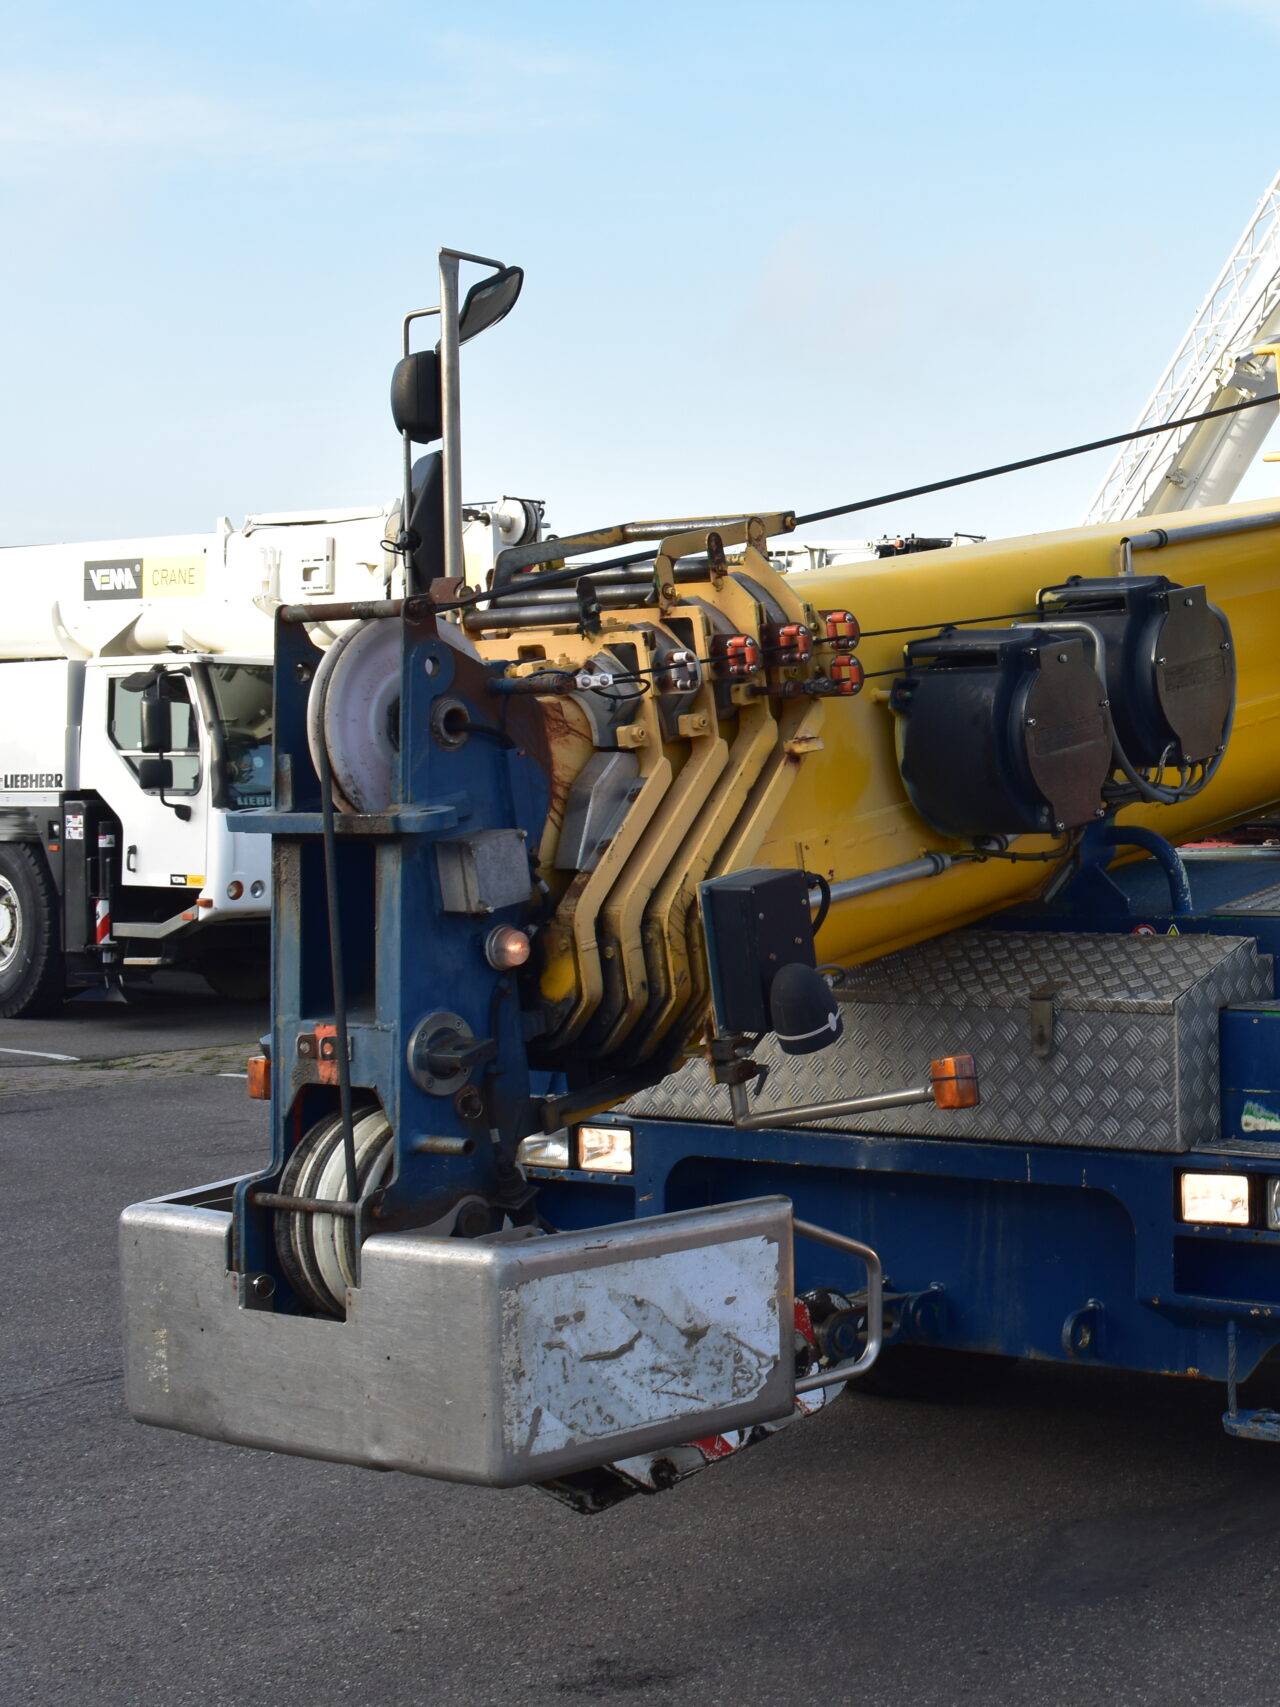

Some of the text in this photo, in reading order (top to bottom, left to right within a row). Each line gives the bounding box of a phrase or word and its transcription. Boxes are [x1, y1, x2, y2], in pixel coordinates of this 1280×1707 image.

[88, 567, 196, 591] VEMA CRANE
[4, 773, 64, 789] LIEBHERR
